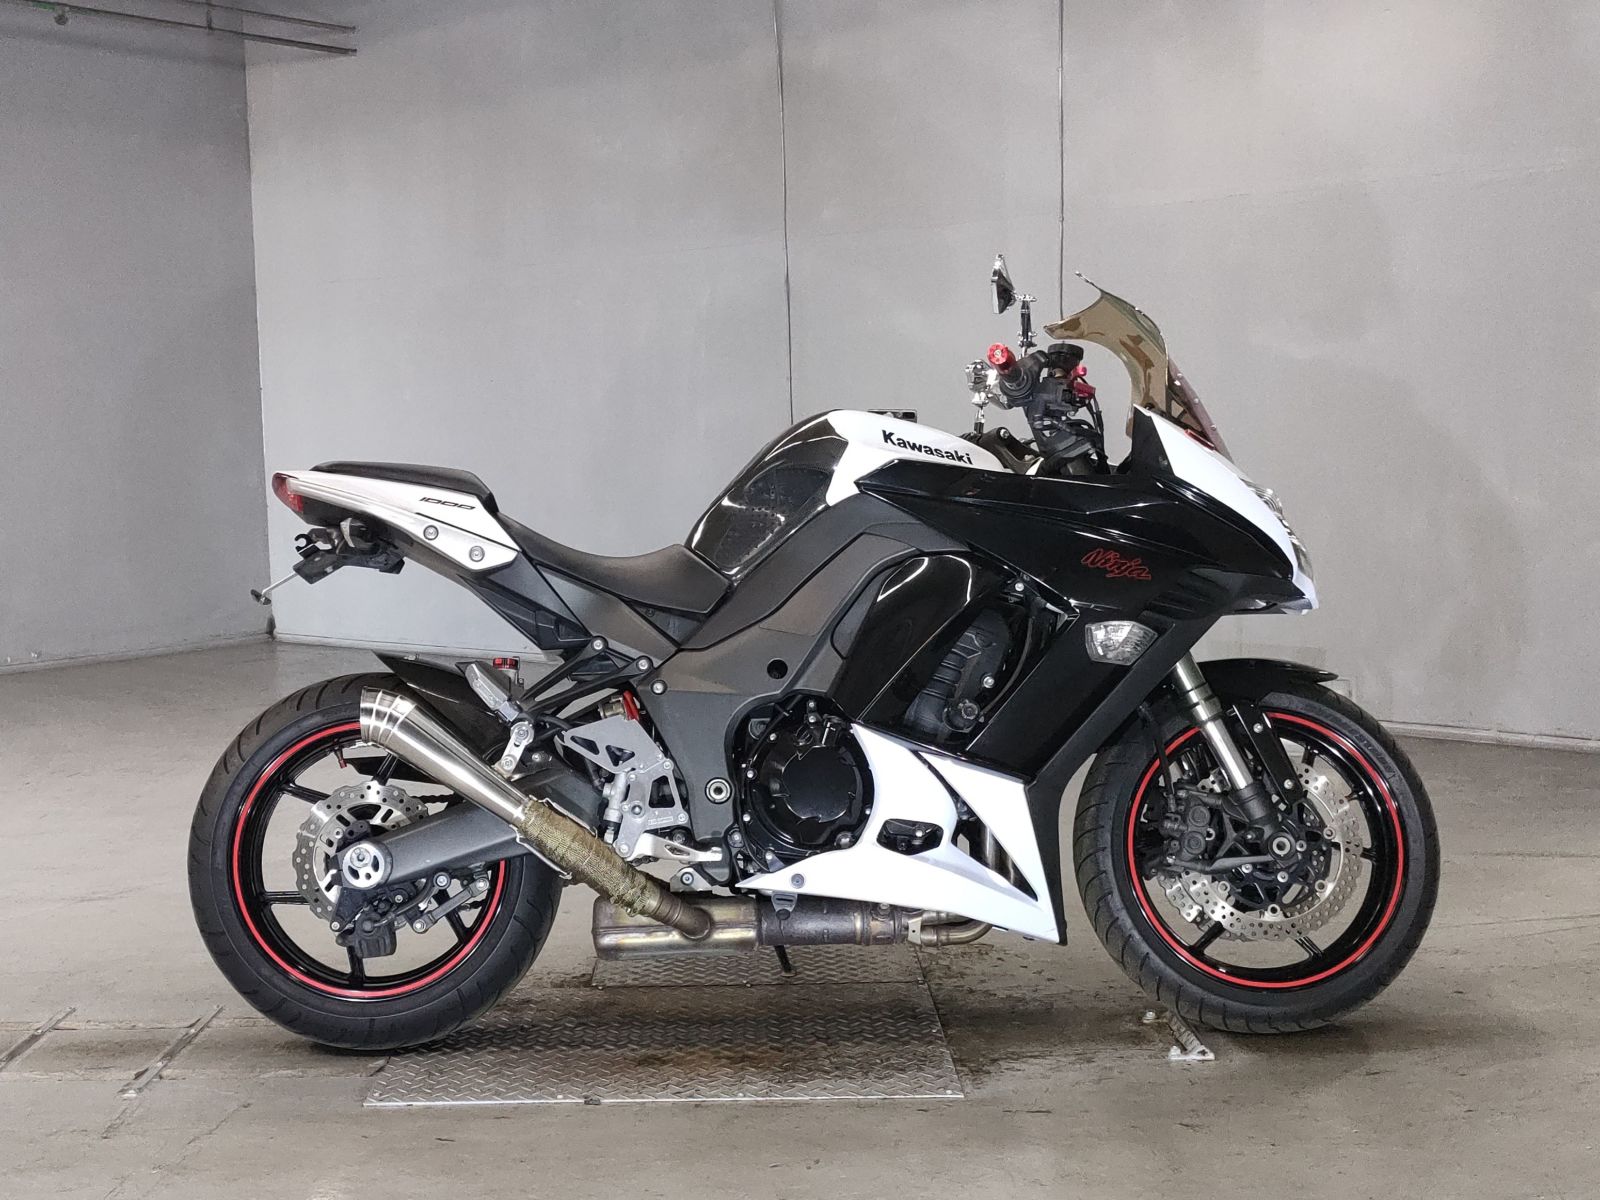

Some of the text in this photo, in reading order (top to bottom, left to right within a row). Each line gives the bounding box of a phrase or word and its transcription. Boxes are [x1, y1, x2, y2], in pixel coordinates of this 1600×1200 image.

[882, 429, 973, 465] Kawasaki
[420, 497, 476, 510] 1000
[1080, 548, 1152, 580] Ninja
